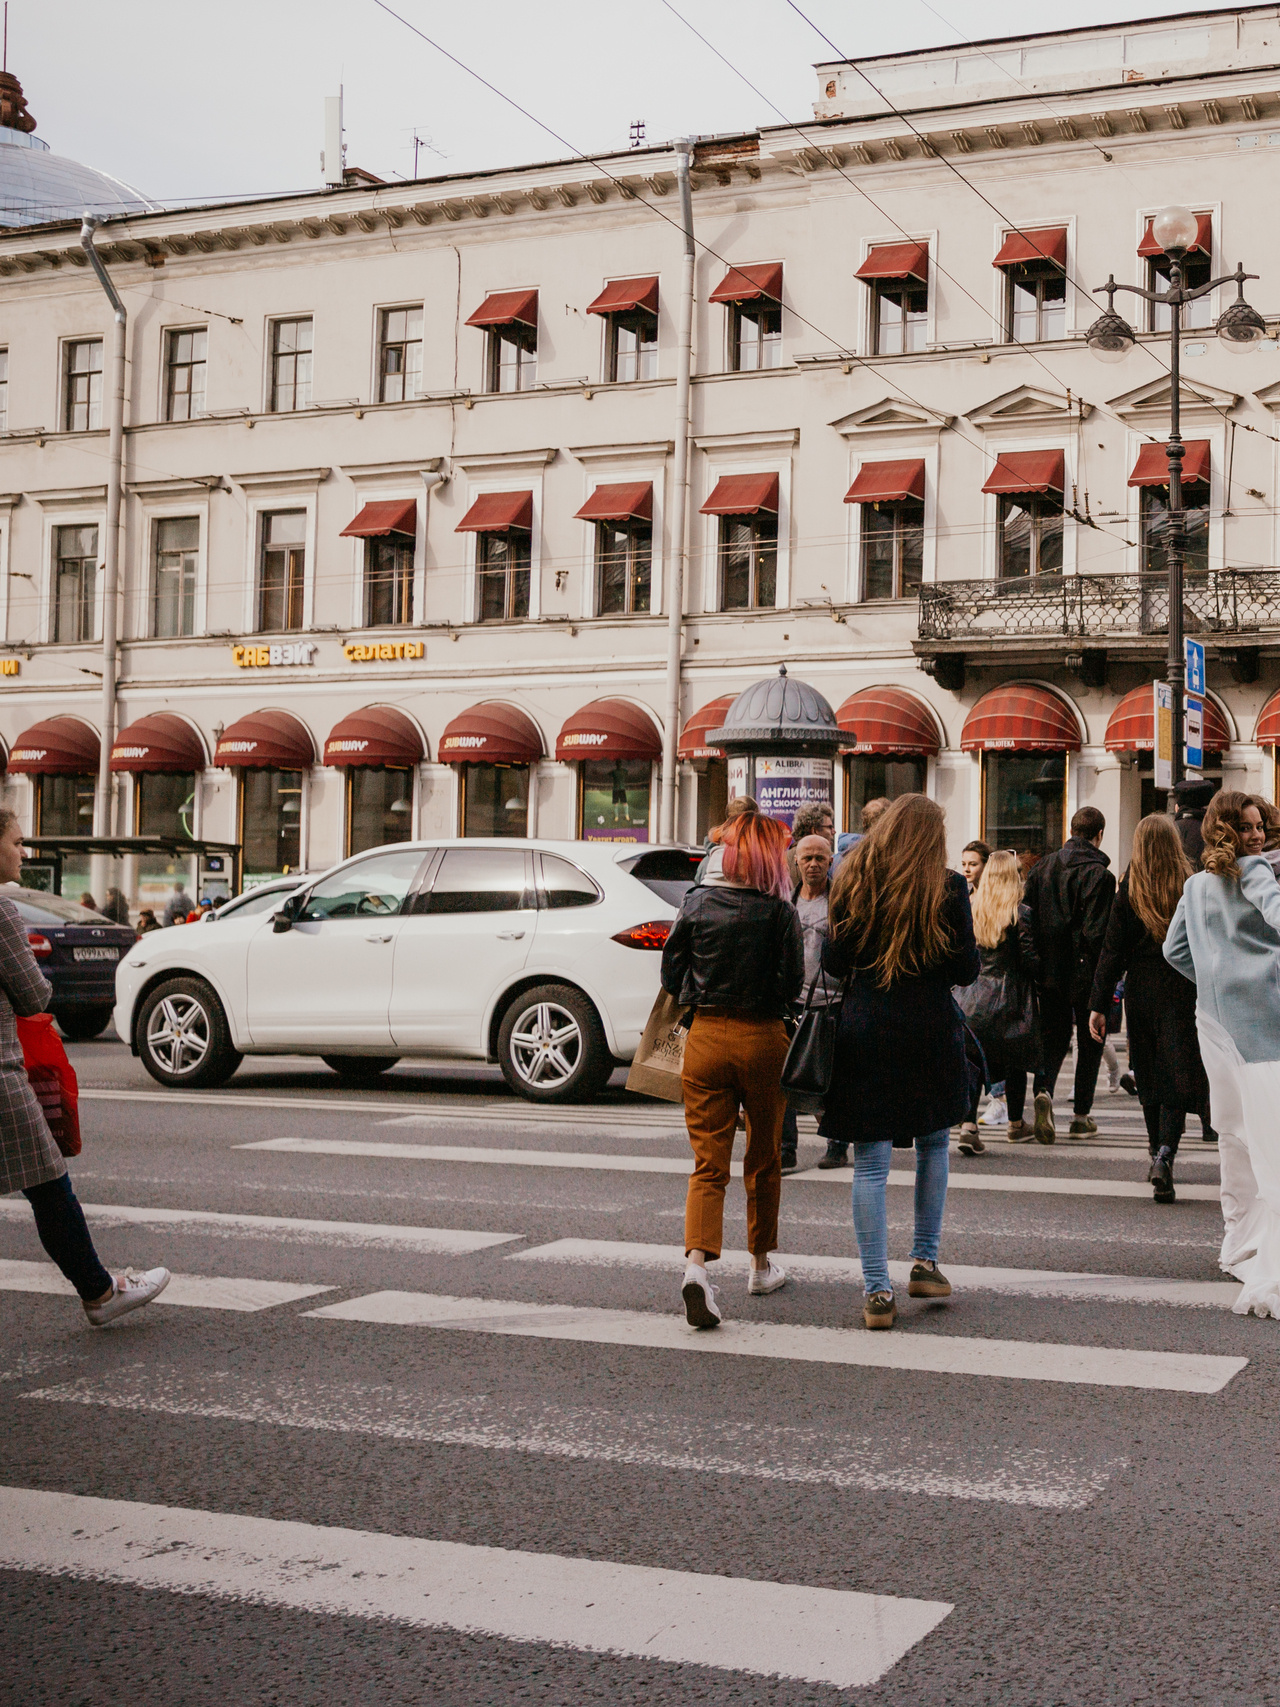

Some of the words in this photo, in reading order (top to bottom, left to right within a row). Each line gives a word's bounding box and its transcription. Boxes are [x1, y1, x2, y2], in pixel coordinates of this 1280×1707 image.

[232, 641, 316, 666] САБВЭЙ
[343, 641, 424, 661] салаты
[327, 740, 369, 753] SUBWAY
[444, 736, 487, 749] SUBWAY
[562, 733, 608, 748] SUBWAY
[984, 740, 1015, 748] BIBLIOTEKA
[111, 747, 150, 759] SUBWAY
[217, 741, 258, 754] SUBWAY
[693, 749, 720, 757] BIBLIOTEKA
[10, 749, 47, 761] SUBWAY
[775, 760, 805, 768] ALIBRA
[760, 799, 772, 808] СО
